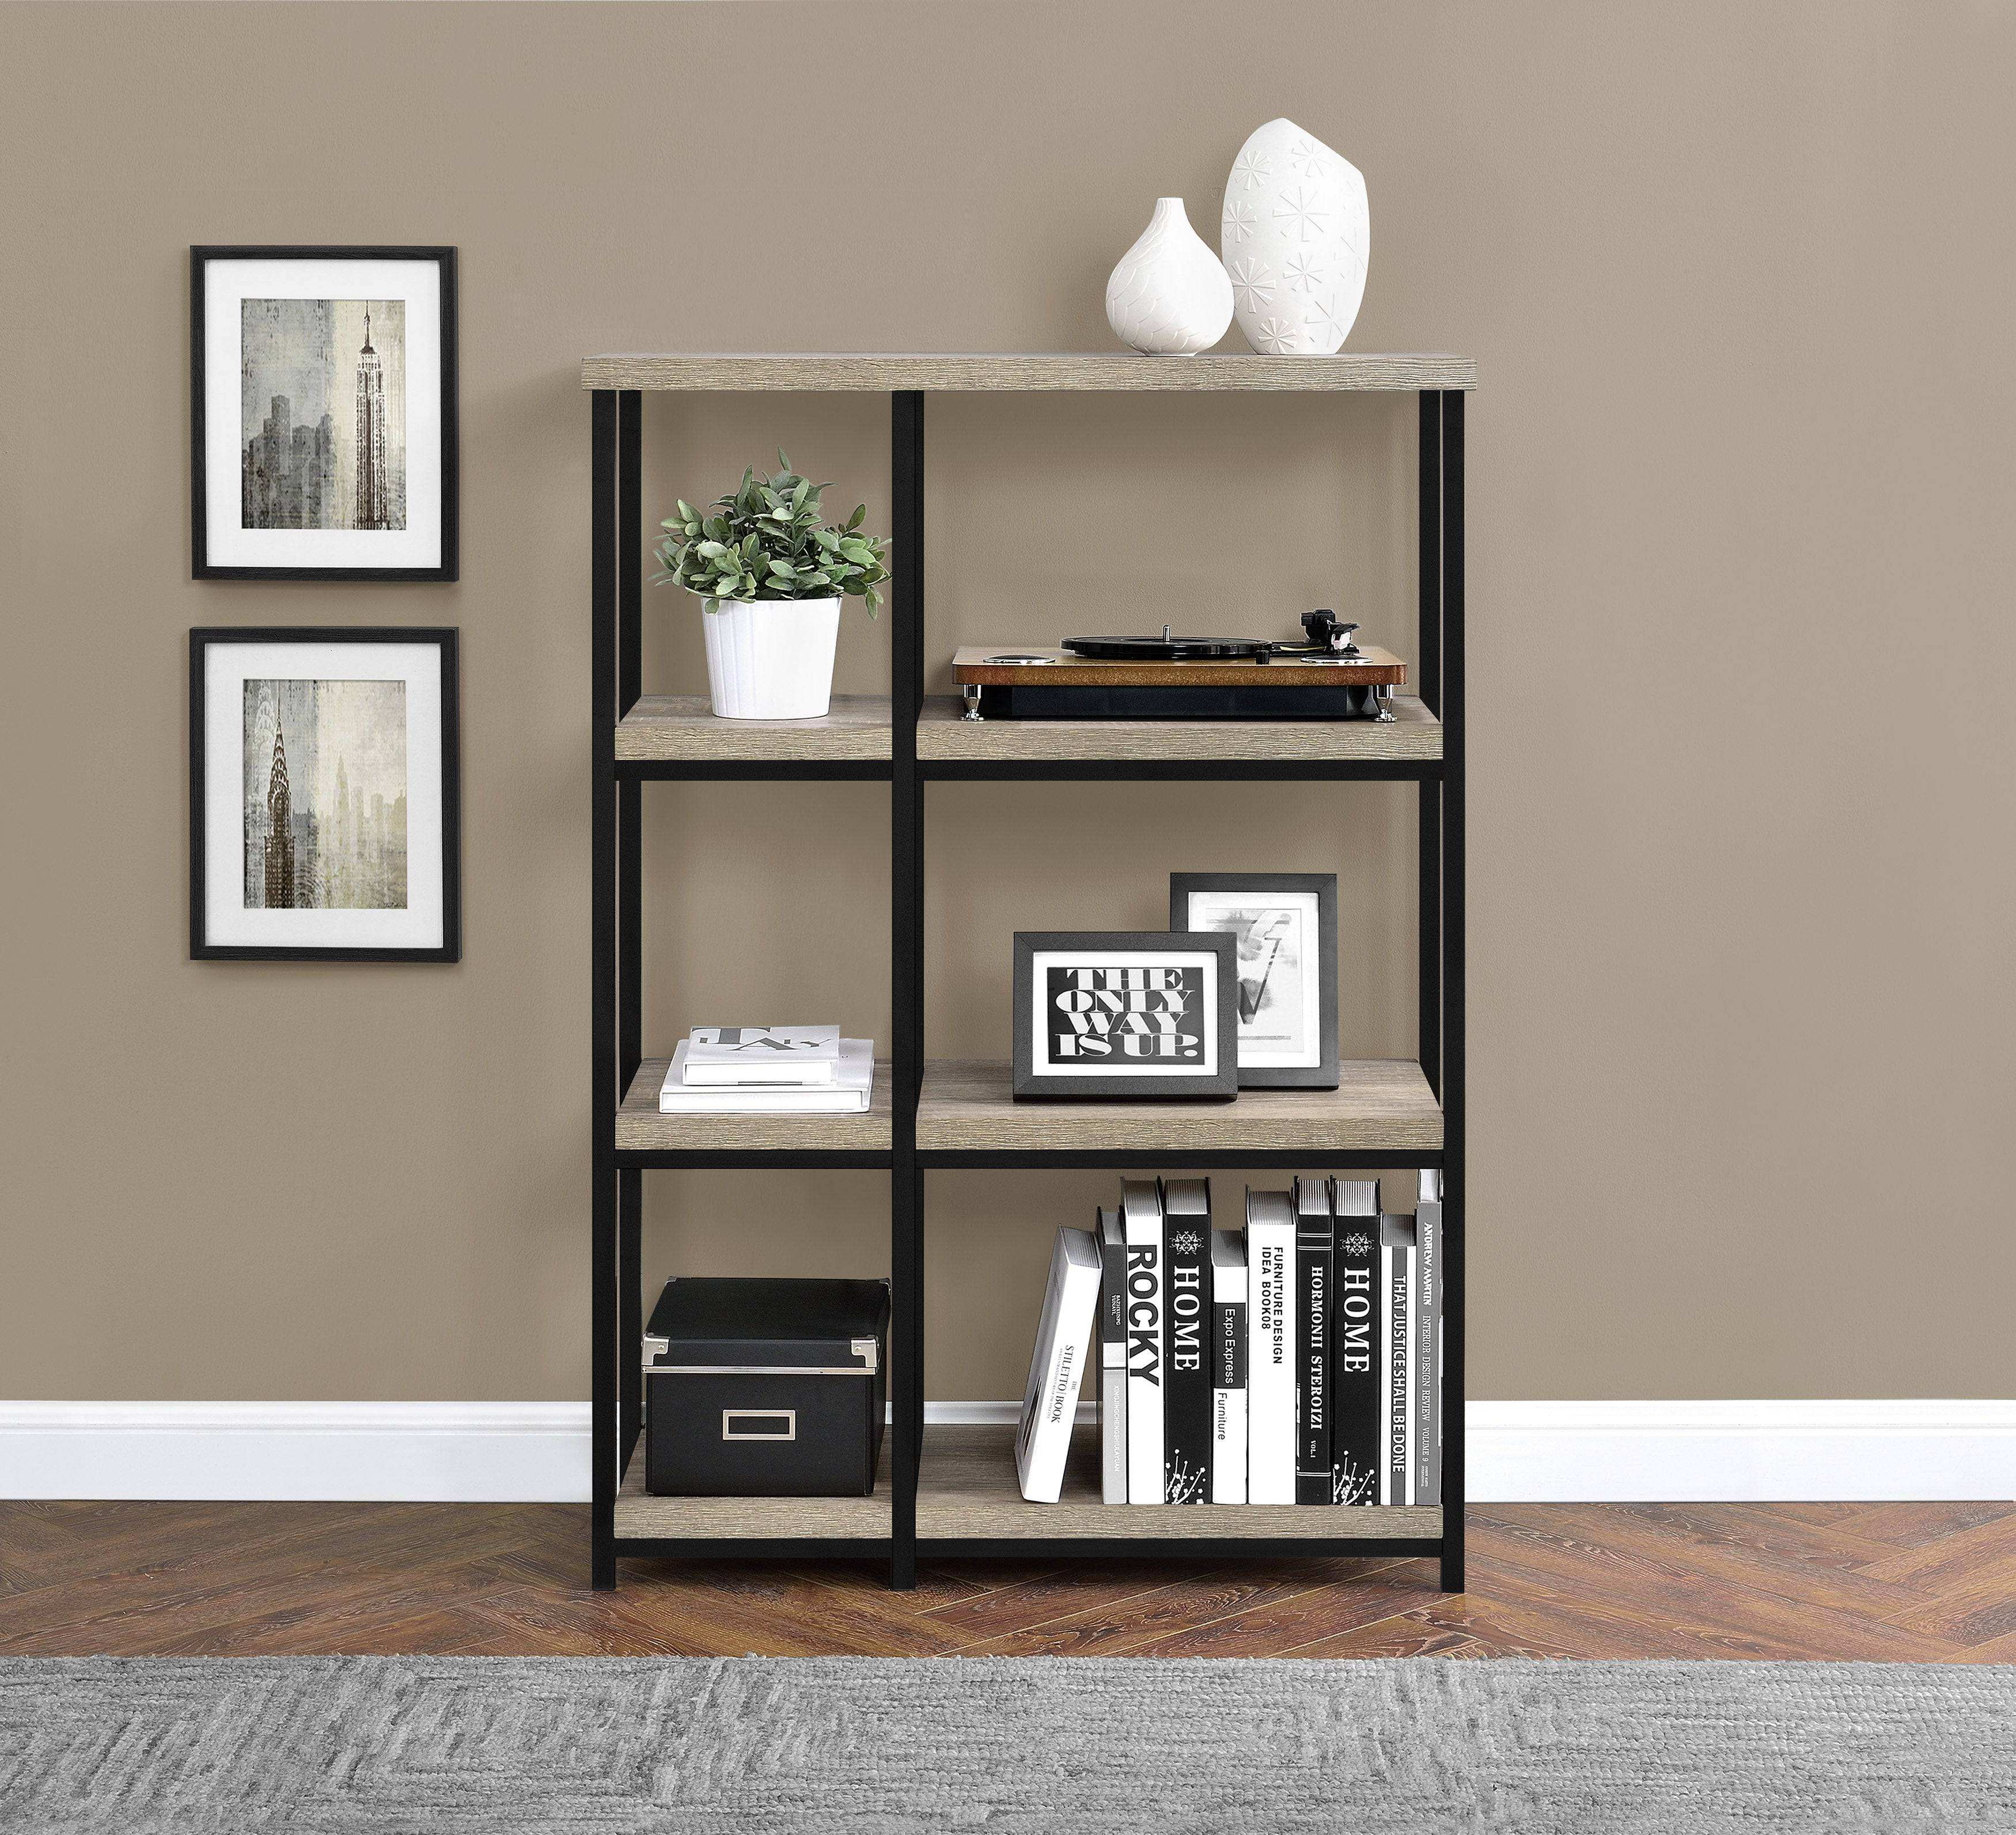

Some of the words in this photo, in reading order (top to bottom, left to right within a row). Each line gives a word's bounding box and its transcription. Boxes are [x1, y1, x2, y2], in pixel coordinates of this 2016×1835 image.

[1066, 968, 1184, 990] THE
[1056, 990, 1195, 1012] ONLY
[1064, 1012, 1189, 1034] WAY
[1055, 1034, 1112, 1056] IS
[1123, 1035, 1198, 1056] UP.
[1263, 1248, 1271, 1274] IDEA
[1424, 1222, 1433, 1266] ANDREW
[1274, 1247, 1283, 1316] FURNITURE
[1393, 1276, 1405, 1309] THAT
[1423, 1267, 1432, 1305] MARTIN
[1128, 1245, 1159, 1386] ROCKY
[1174, 1266, 1199, 1370] HOME
[1223, 1309, 1235, 1336] Expo
[1312, 1267, 1322, 1348] HORMONII
[1344, 1268, 1370, 1371] HOME
[1274, 1320, 1282, 1363] DESIGN
[1393, 1310, 1405, 1368] JUSTICE
[1058, 1345, 1074, 1392] STILETTO
[1223, 1340, 1235, 1383] Express
[1422, 1357, 1430, 1386] DESIGN
[1051, 1396, 1064, 1423] BOOK
[1311, 1356, 1322, 1429] STEROIZI
[1393, 1369, 1405, 1413] SHALL
[1218, 1393, 1227, 1439] Furniture
[1393, 1416, 1404, 1431] BE
[1393, 1435, 1404, 1472] DONE
